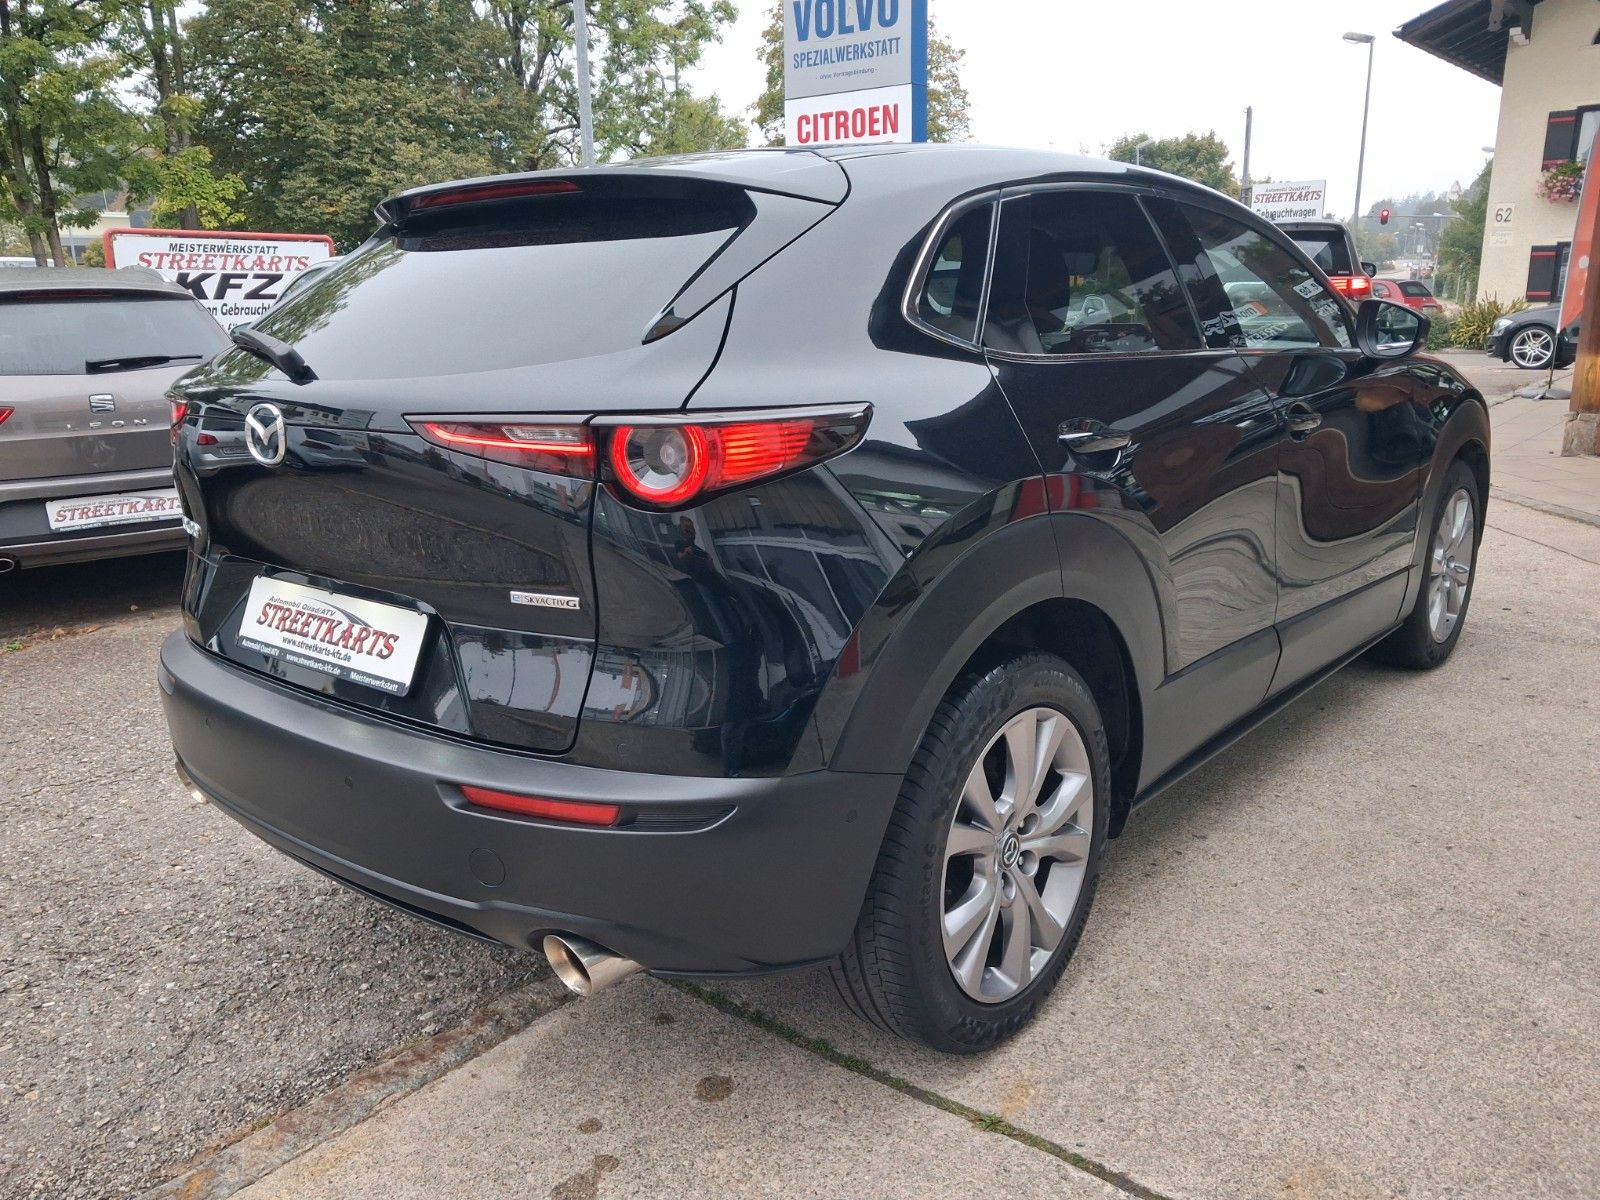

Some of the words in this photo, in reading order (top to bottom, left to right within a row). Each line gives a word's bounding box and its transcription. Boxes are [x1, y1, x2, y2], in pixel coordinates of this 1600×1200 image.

[793, 0, 899, 42] VOLVO
[793, 37, 901, 69] SPEZIALWERKSTATT
[797, 103, 899, 144] CITROEN
[1253, 190, 1322, 203] STREETKARTS
[1256, 208, 1316, 219] Gebrauchtwagen
[1495, 207, 1512, 223] 62
[169, 242, 278, 254] MEISTERWERKSTATT
[138, 252, 310, 272] STREETKARTS
[176, 272, 284, 300] KFZ
[269, 595, 301, 609] Automobil
[256, 602, 399, 660] STREETKARTS
[282, 637, 352, 662] www.streetkarts-kfz.de
[349, 671, 399, 692] Meisterwerkstatt
